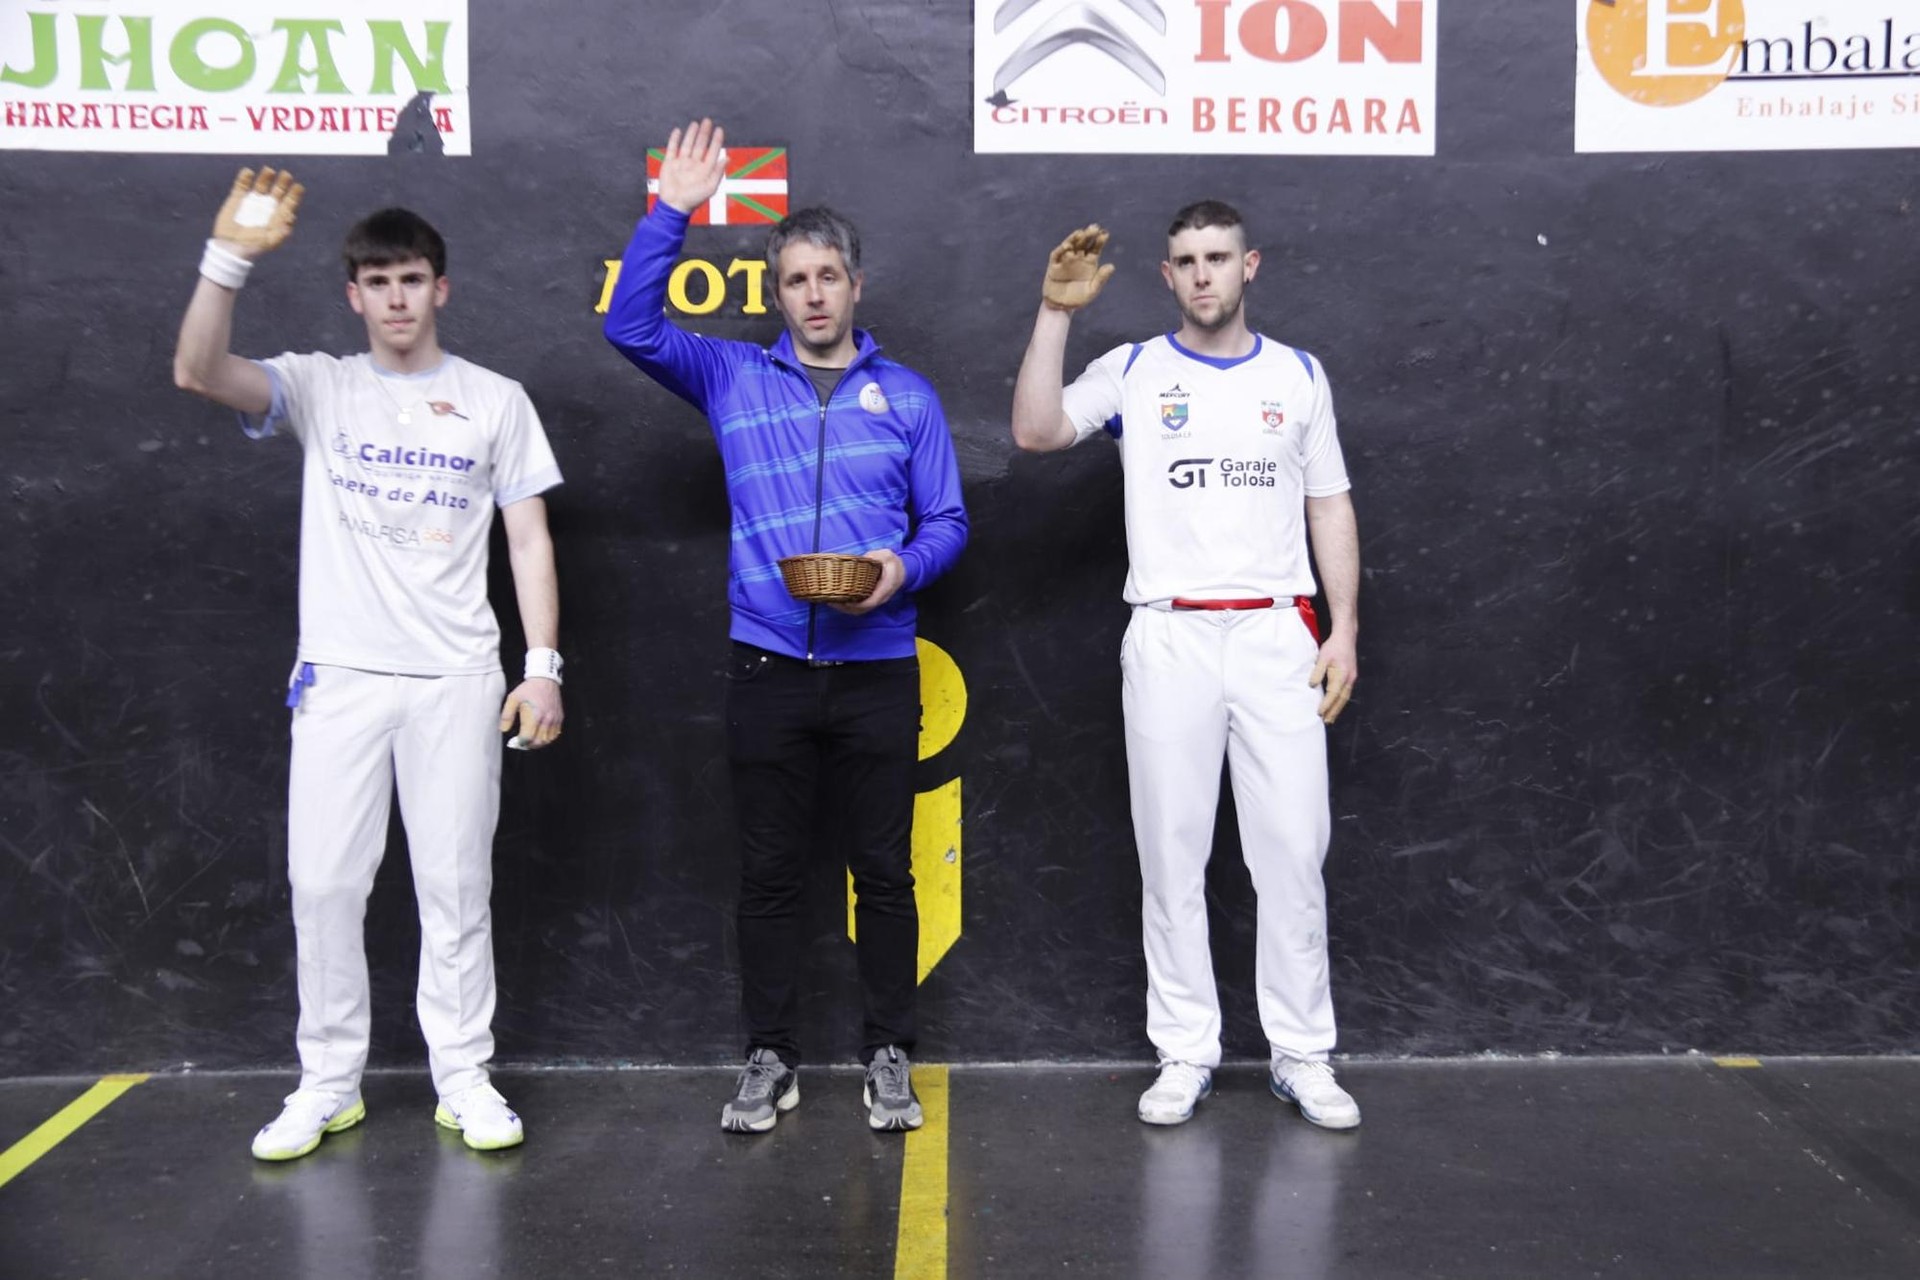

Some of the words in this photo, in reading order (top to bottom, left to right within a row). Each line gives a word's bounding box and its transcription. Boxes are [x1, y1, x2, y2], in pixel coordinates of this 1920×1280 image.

[1194, 0, 1422, 63] ION
[0, 12, 453, 95] JHOAN
[5, 101, 210, 130] HARATEGIA
[246, 106, 454, 133] VRDAITEA
[1192, 97, 1422, 134] BERGARA
[1736, 96, 1874, 119] Enbalaje
[359, 443, 476, 472] Calcinor
[1220, 457, 1277, 475] Garaje
[1220, 472, 1276, 488] Tolosa
[387, 487, 415, 503] de
[421, 489, 469, 510] Alzo
